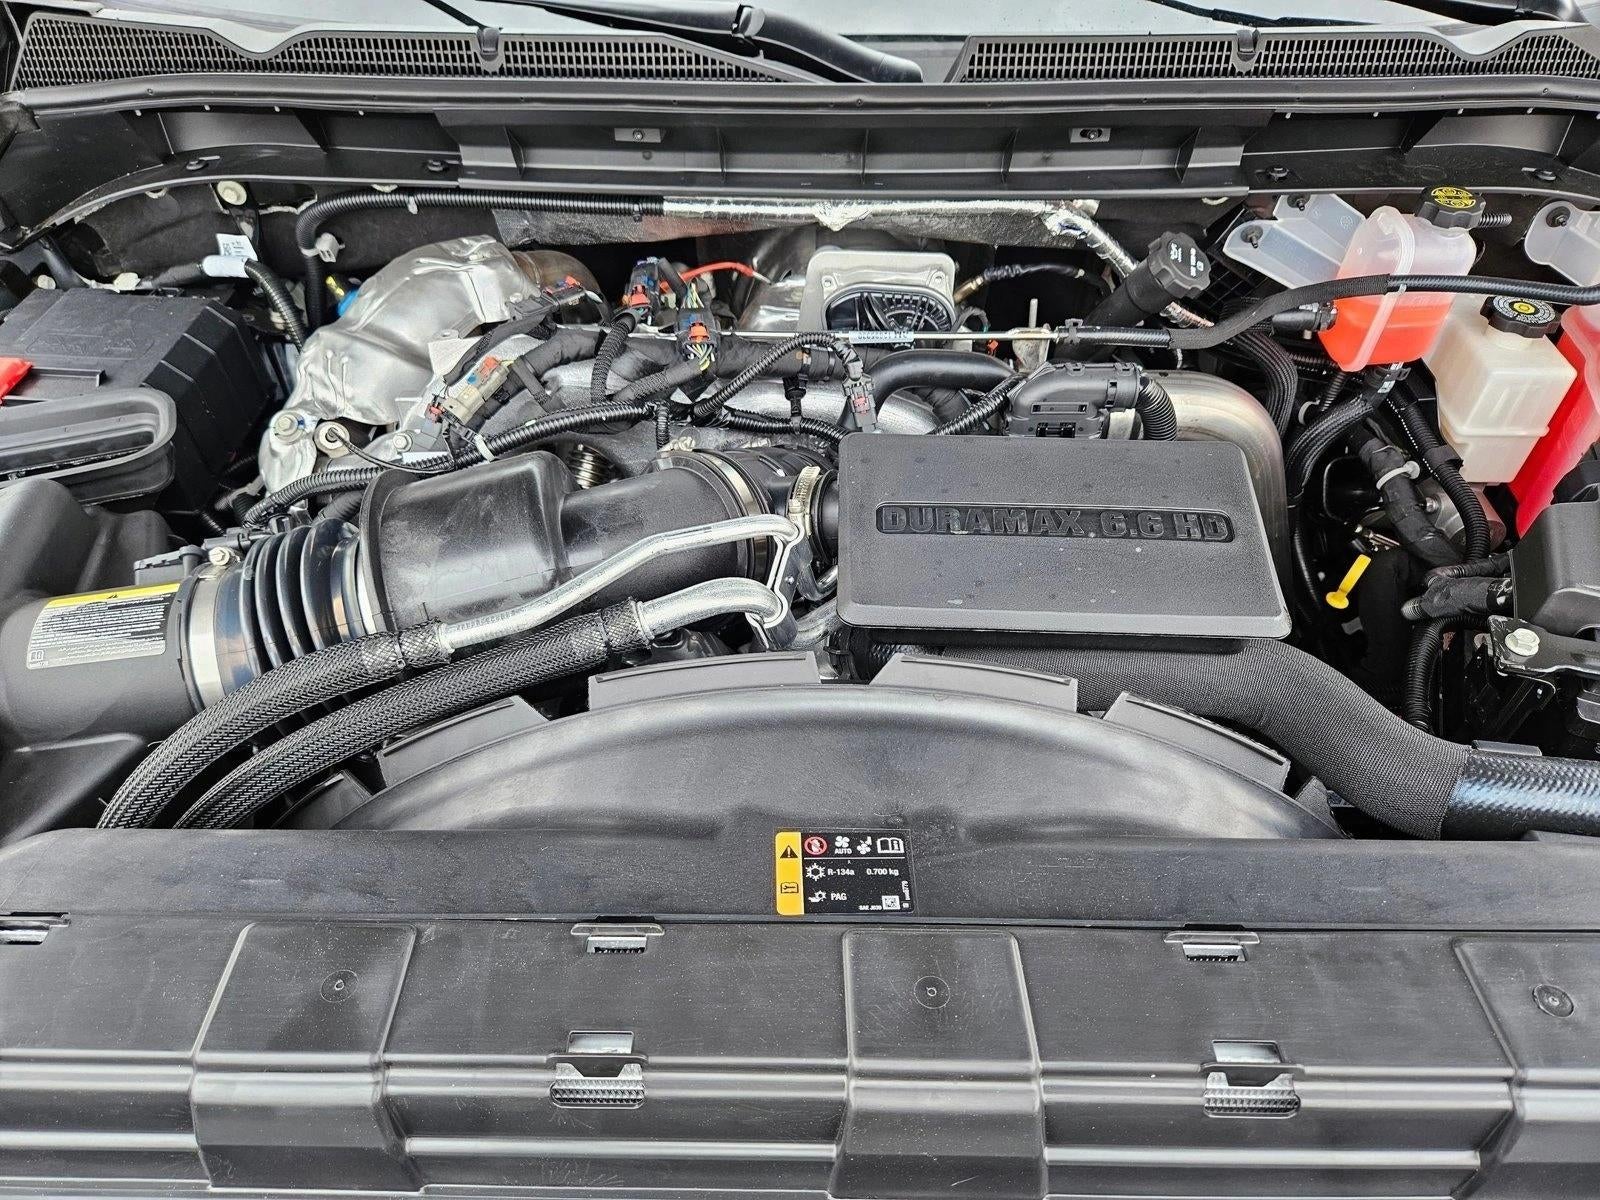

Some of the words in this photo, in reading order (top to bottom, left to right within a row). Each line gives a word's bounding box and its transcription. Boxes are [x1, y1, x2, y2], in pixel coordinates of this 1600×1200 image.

[881, 506, 1085, 536] DURAMAX
[1099, 510, 1165, 539] 6.6
[1174, 511, 1230, 542] HD
[827, 868, 855, 876] R-134a
[866, 868, 887, 876] 0.700
[888, 868, 899, 877] kg
[830, 892, 847, 901] PAG
